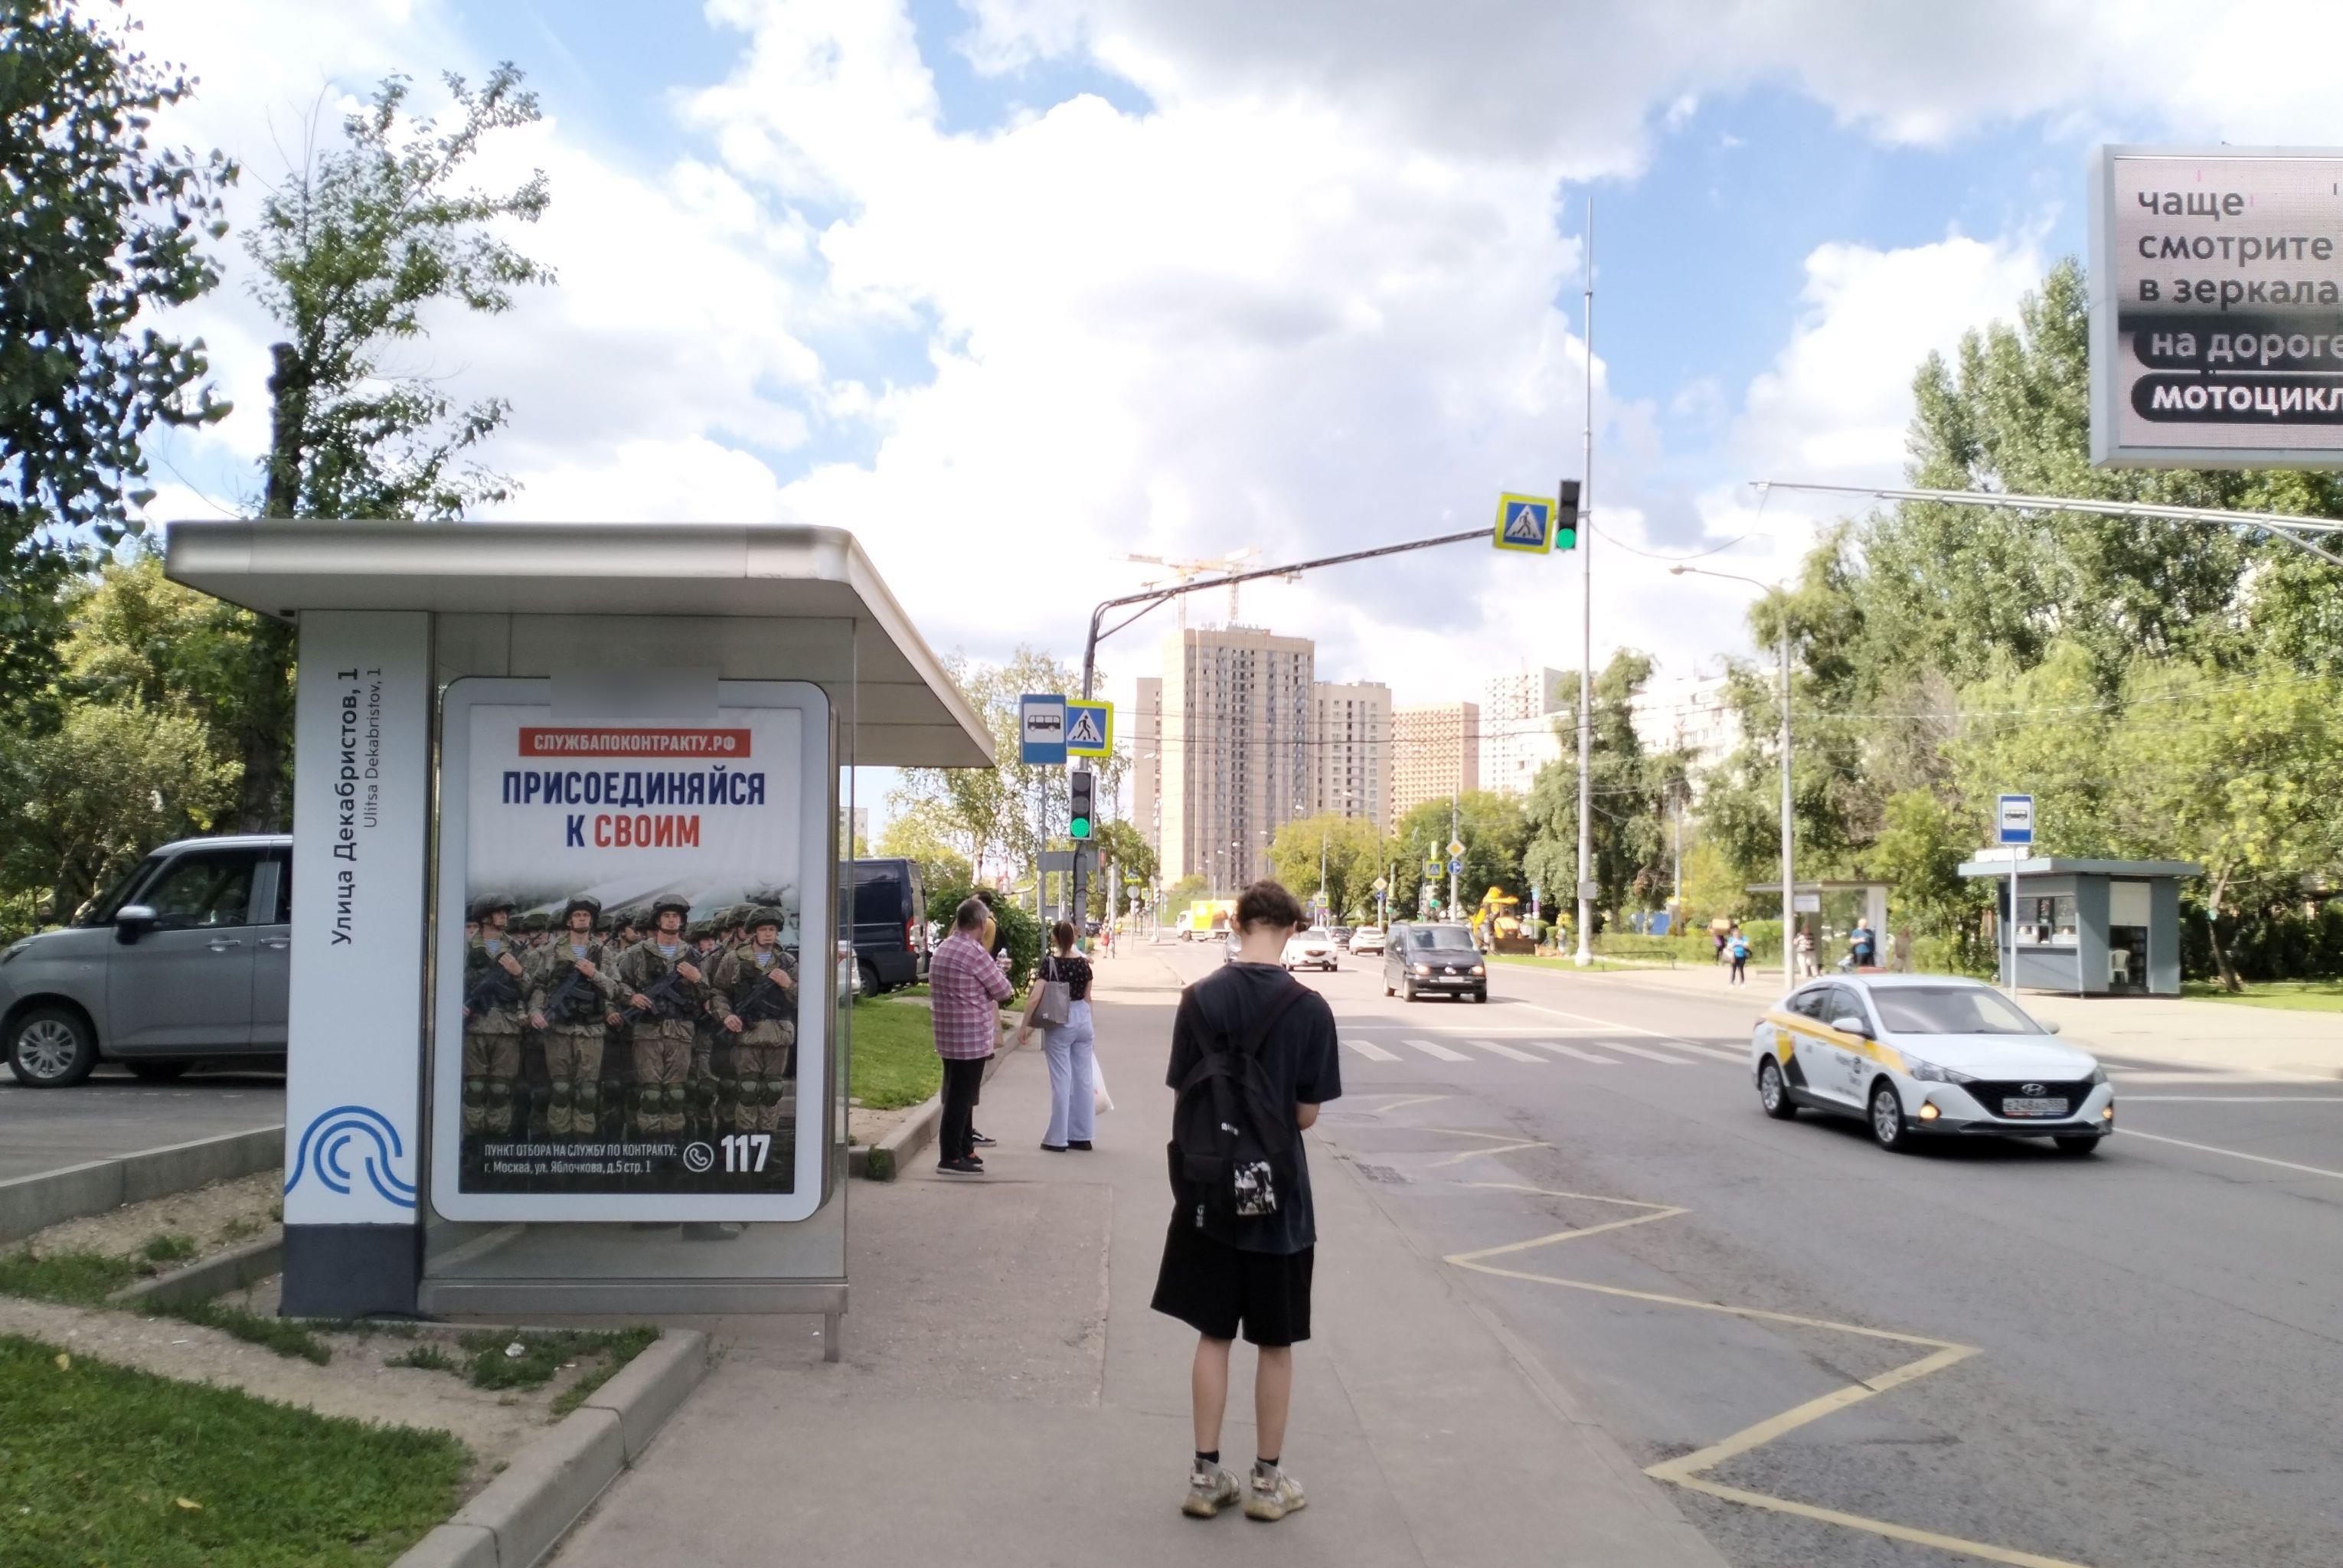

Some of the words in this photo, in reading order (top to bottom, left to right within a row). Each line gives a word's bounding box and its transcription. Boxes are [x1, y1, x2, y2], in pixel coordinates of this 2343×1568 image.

[2138, 191, 2244, 221] чаще
[2139, 234, 2334, 267] смотрите
[2139, 279, 2161, 302] в
[2152, 332, 2196, 356] на
[337, 668, 359, 681] 1
[367, 668, 381, 677] 1
[364, 681, 384, 779] Dekabristov,
[534, 733, 737, 752] СЛУЖБАПОКОНТРАКТУ.РФ
[334, 688, 361, 862] Декабристов,
[502, 765, 765, 808] ПРИСОЕДИНЯЙСЯ
[364, 784, 378, 828] Ulitsa
[566, 815, 585, 848] К
[594, 815, 700, 848] СВОИМ
[331, 870, 356, 946] Улица
[484, 1144, 514, 1157] ПУНКТ
[516, 1144, 551, 1157] ОТБОРА
[553, 1144, 566, 1157] НА
[567, 1144, 605, 1157] СЛУЖБУ
[607, 1144, 620, 1157] ПО
[623, 1144, 677, 1157] КОНТРАКТУ:
[721, 1133, 771, 1174] 117
[484, 1162, 492, 1173] г.
[493, 1161, 533, 1175] Москва,
[534, 1162, 548, 1176] ул.
[551, 1161, 605, 1175] Яблочкова,
[623, 1162, 643, 1176] стр.
